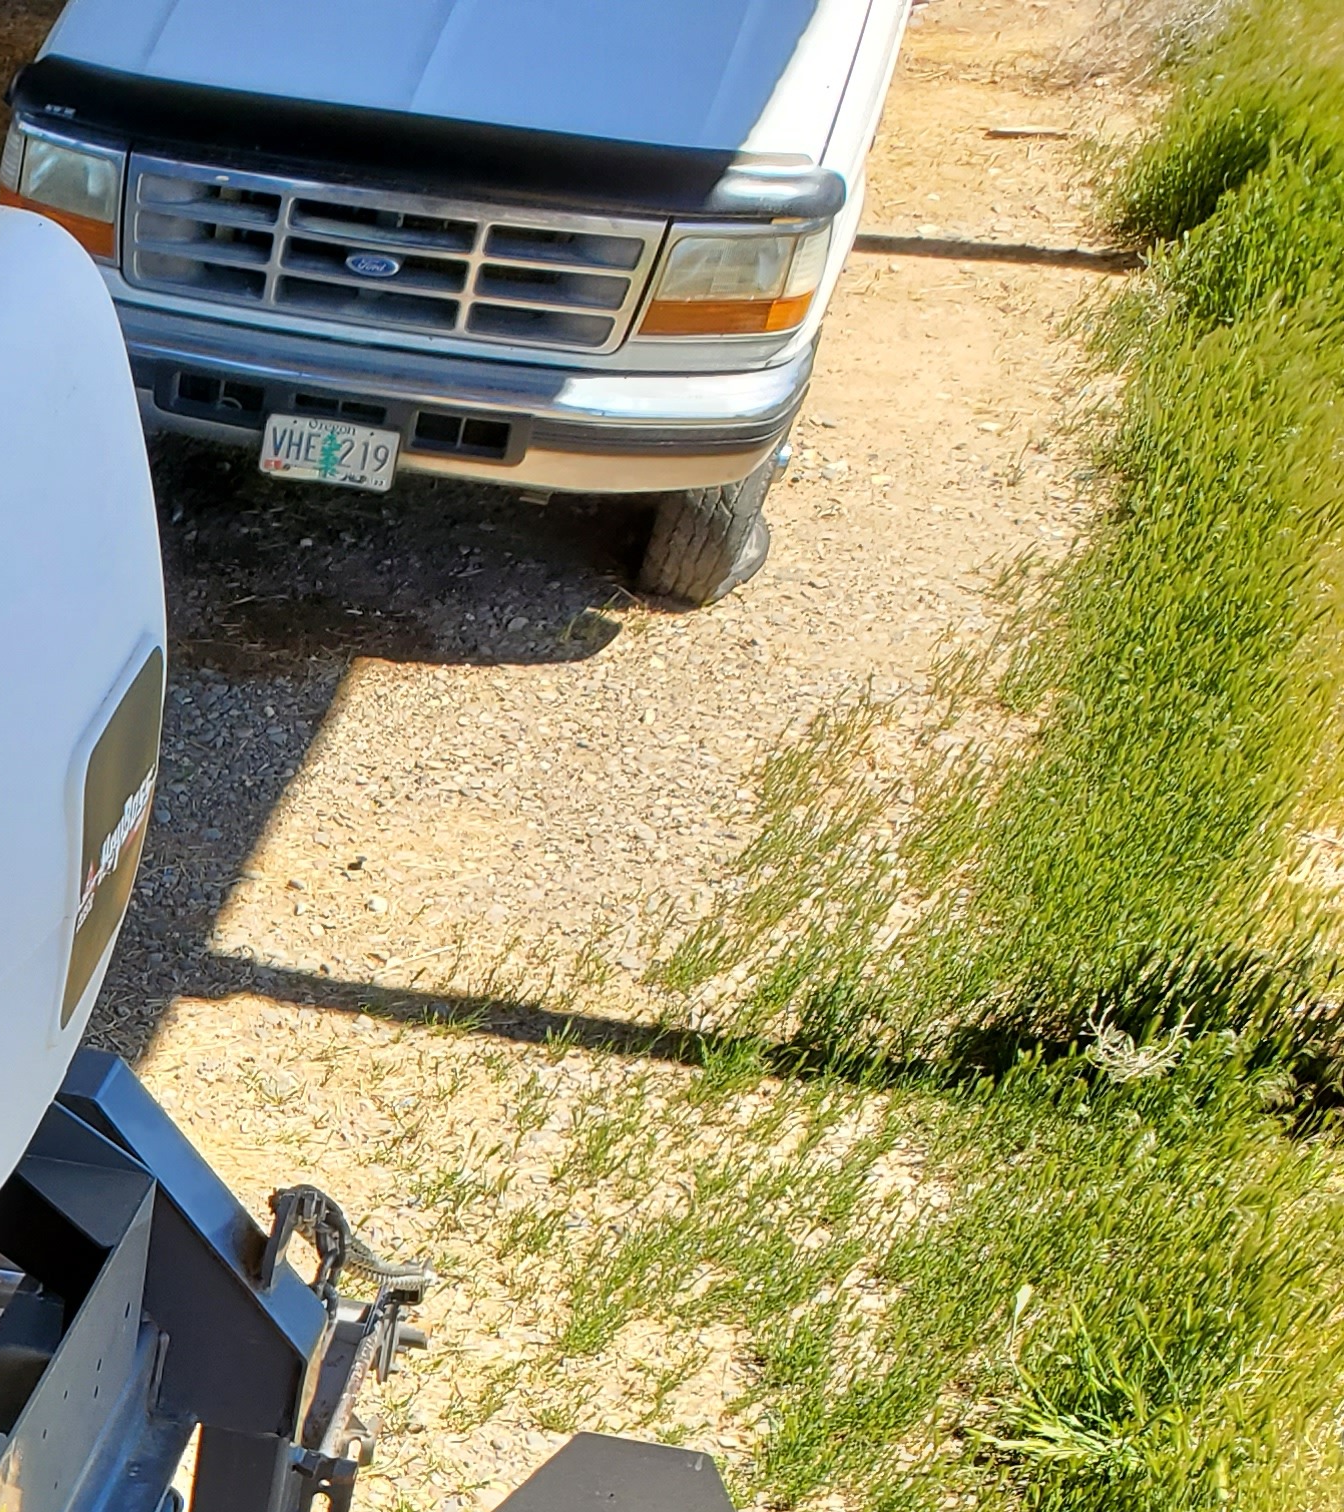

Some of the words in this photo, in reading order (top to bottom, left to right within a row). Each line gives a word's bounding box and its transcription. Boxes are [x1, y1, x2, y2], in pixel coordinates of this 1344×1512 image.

[357, 258, 387, 272] Ford
[308, 418, 356, 436] Oregon
[272, 426, 321, 463] VHE
[336, 438, 390, 473] 219
